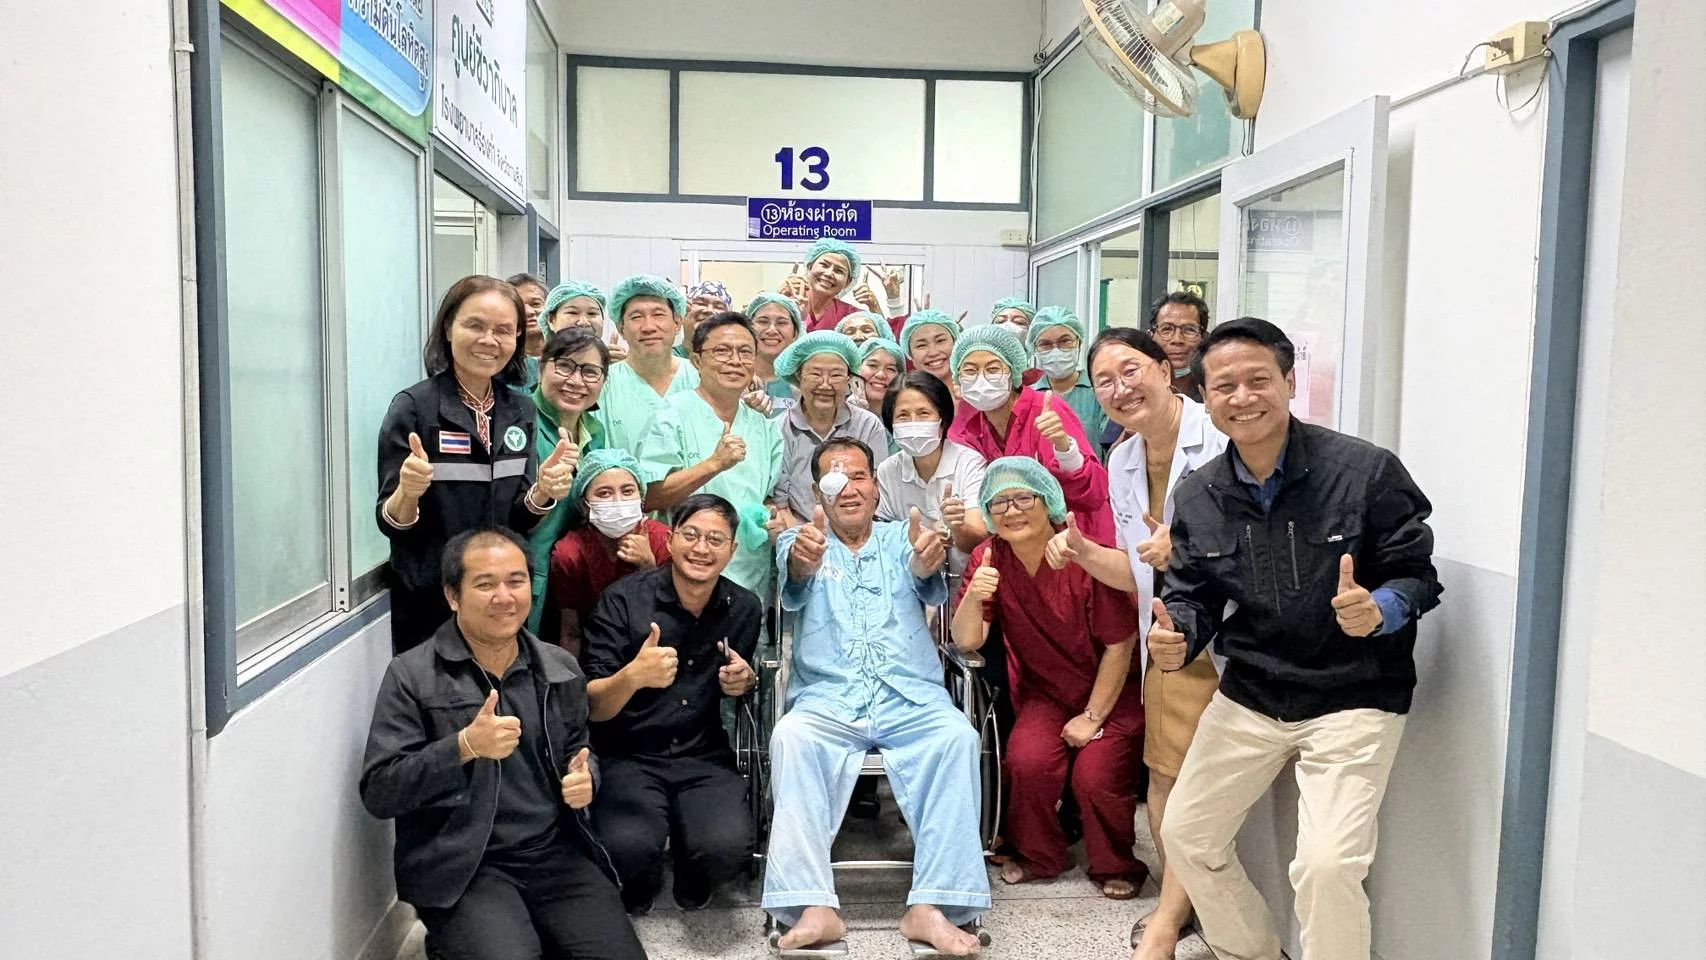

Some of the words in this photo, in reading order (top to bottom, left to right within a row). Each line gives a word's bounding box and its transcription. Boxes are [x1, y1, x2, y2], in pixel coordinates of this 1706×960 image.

[451, 14, 518, 128] ศูนย์ชีวาภิบาล
[775, 146, 830, 191] 13
[781, 200, 857, 222] ห้องผ่าตัด
[763, 225, 820, 238] Operating
[823, 225, 857, 237] Room
